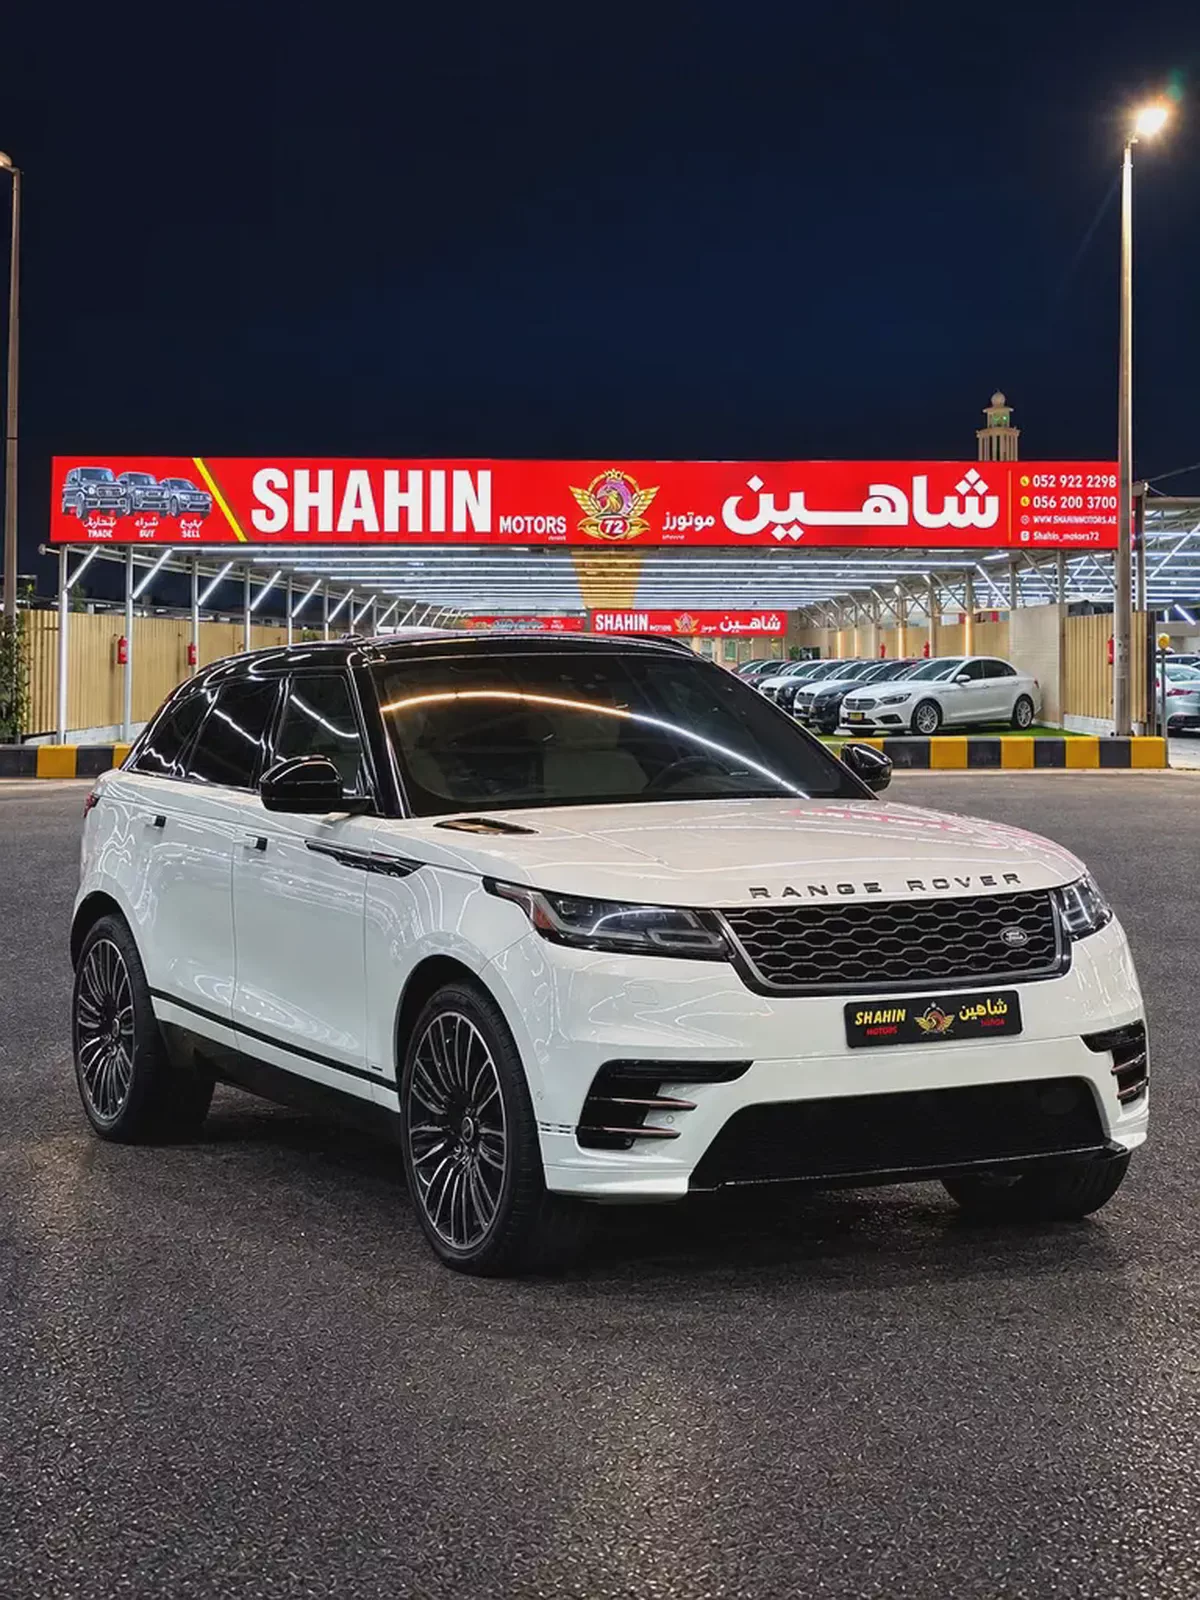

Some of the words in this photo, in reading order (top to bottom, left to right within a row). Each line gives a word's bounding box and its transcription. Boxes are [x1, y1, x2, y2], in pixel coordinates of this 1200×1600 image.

[1032, 474, 1056, 488] 052
[1060, 474, 1083, 488] 922
[1086, 474, 1117, 488] 2298
[251, 468, 492, 534] SHAHIN
[721, 468, 1000, 541] شاهين
[1032, 495, 1057, 509] 056
[1060, 495, 1083, 509] 200
[1087, 495, 1117, 509] 3700
[499, 516, 567, 533] MOTORS
[605, 519, 623, 534] 72
[662, 512, 715, 532] موتورز
[87, 529, 113, 538] TRADE
[595, 613, 648, 631] SHAHIN
[719, 613, 781, 633] شاهين
[749, 882, 882, 899] RANGE
[906, 873, 1022, 892] ROVER
[855, 1009, 906, 1026] SHAHIN
[959, 998, 1008, 1021] شاهين
